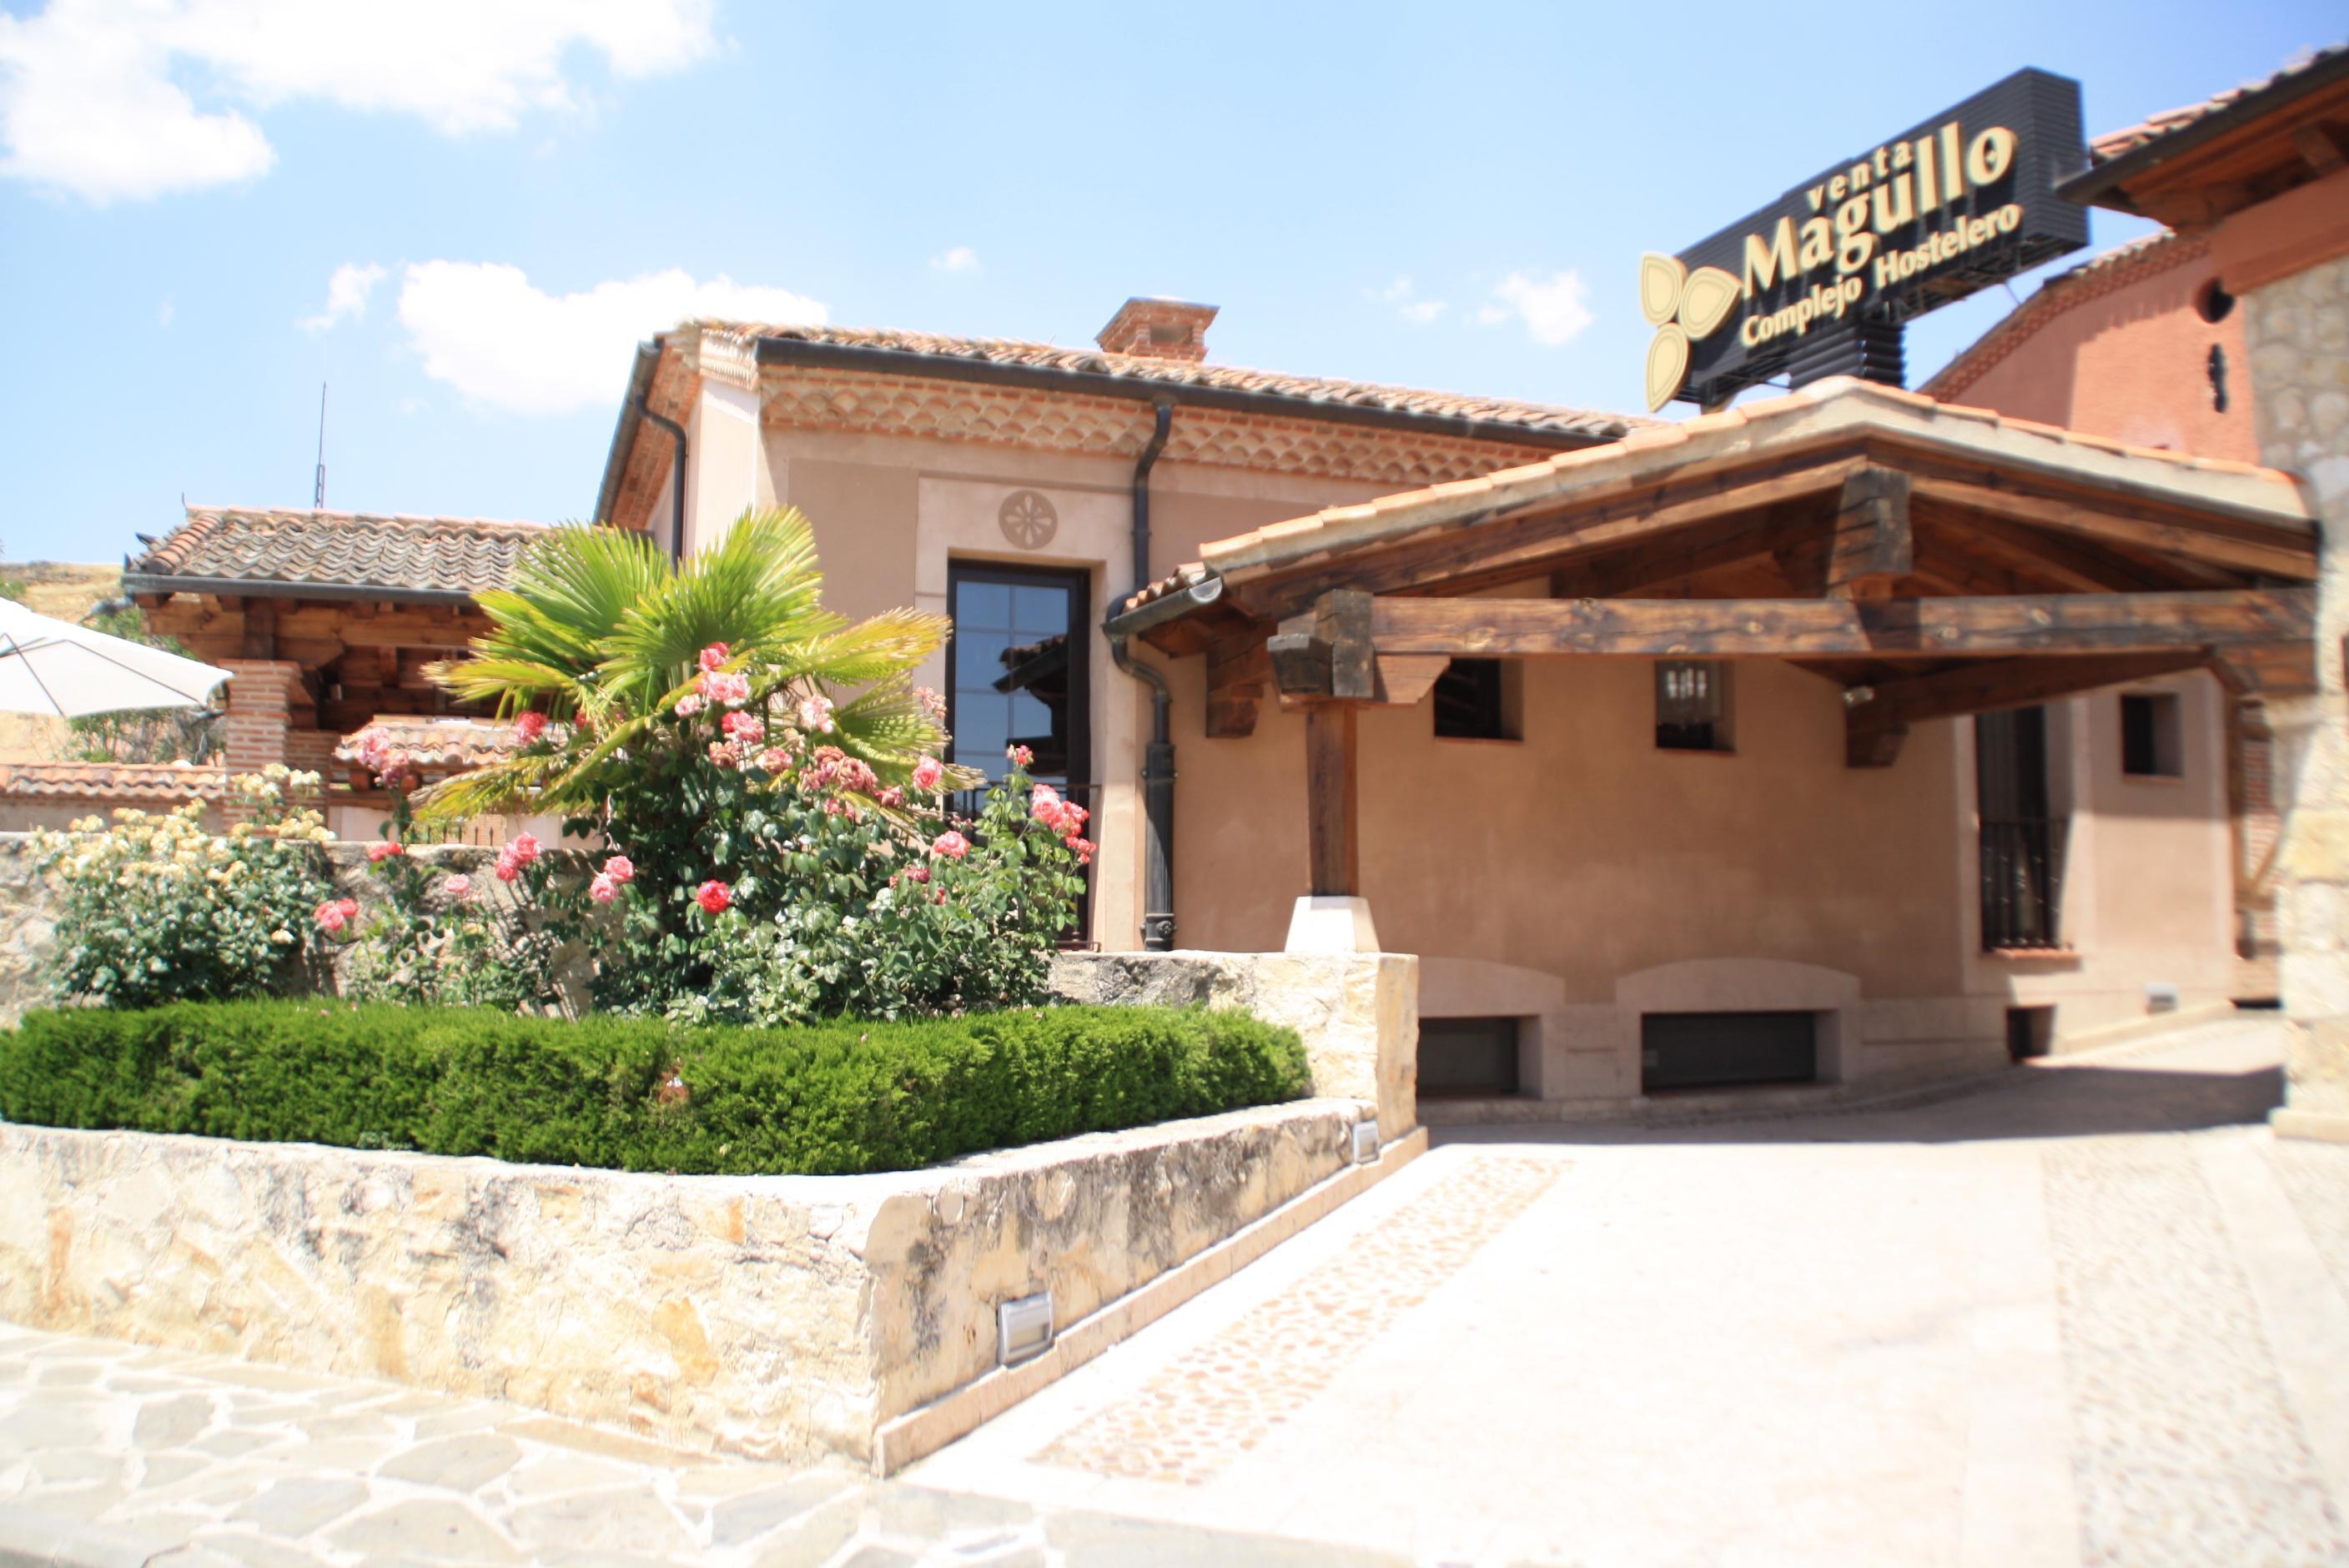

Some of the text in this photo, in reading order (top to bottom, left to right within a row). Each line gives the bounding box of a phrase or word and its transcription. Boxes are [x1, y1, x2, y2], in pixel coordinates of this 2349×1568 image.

[1742, 121, 2018, 299] Magullo
[1807, 141, 1913, 211] venta
[1741, 204, 2024, 348] Complejo Hostelero
